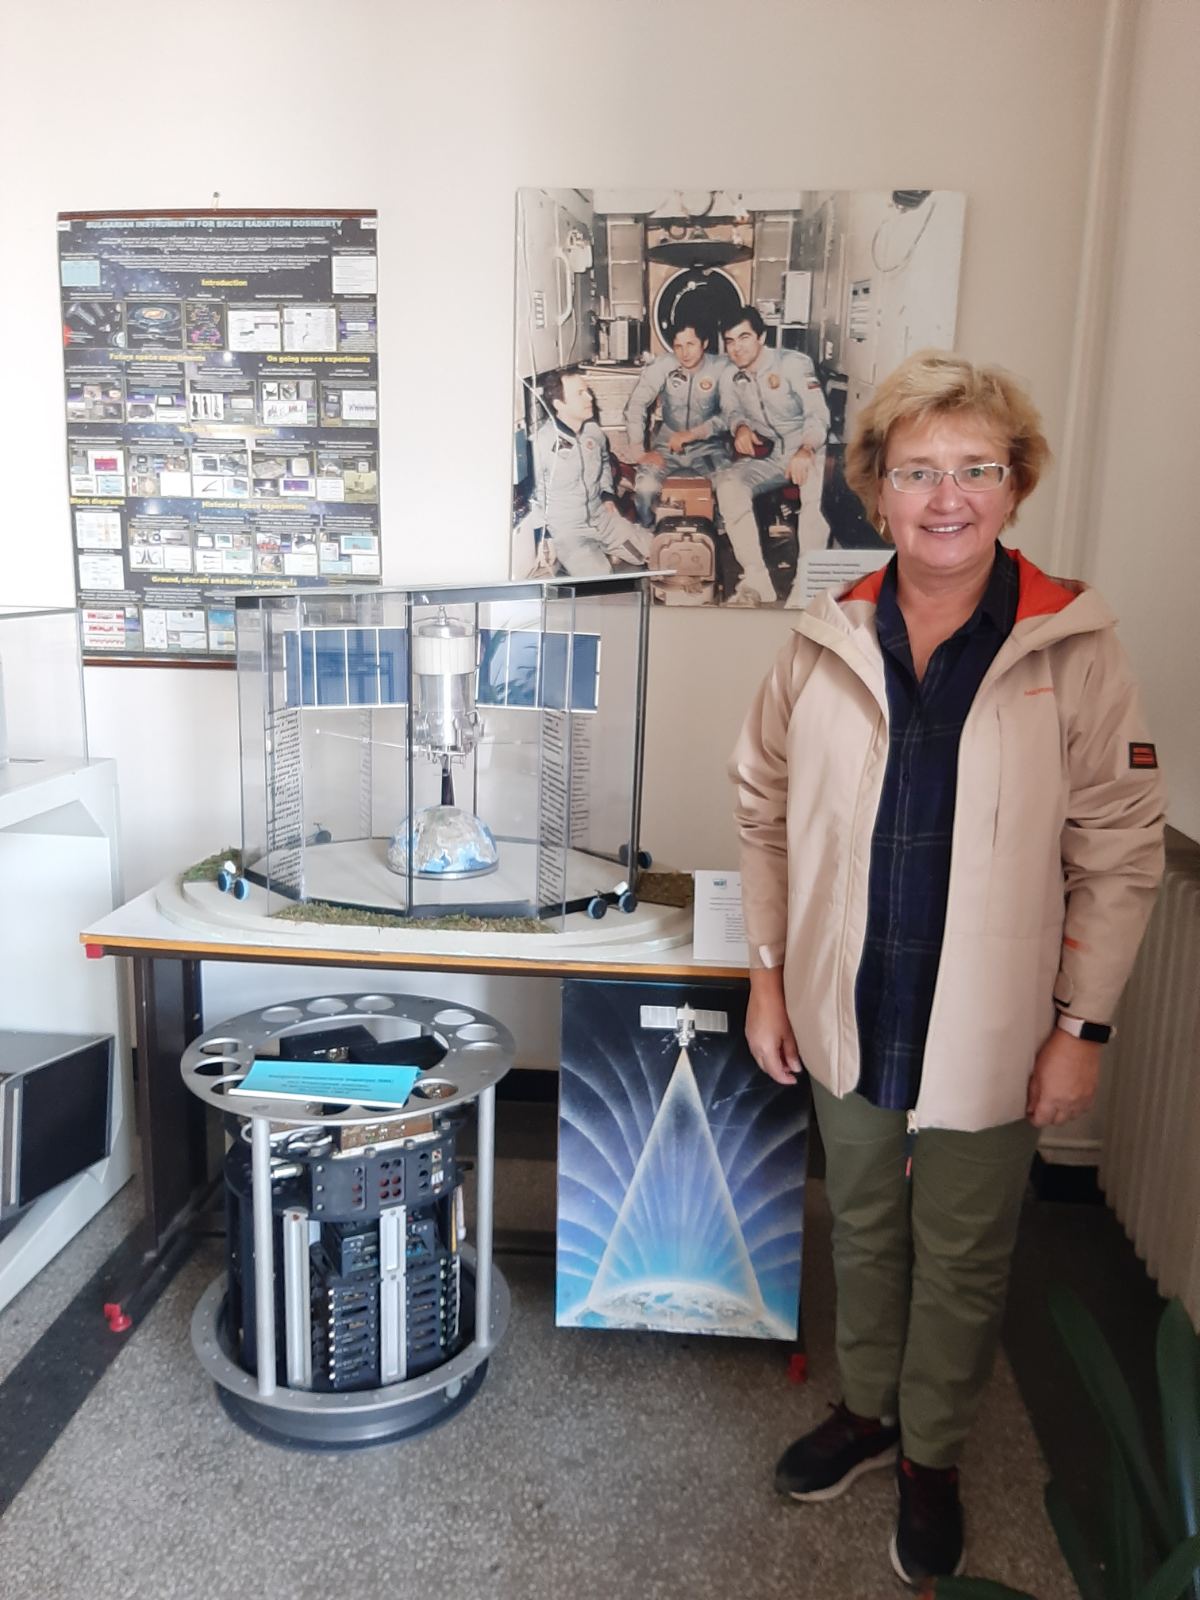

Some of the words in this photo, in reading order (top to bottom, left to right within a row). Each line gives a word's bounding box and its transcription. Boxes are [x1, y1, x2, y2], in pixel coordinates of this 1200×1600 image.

[196, 220, 215, 228] FOR
[216, 219, 243, 228] SPACE
[201, 279, 248, 287] Introduction
[279, 356, 299, 364] going
[300, 356, 323, 364] space
[324, 356, 370, 364] experiments
